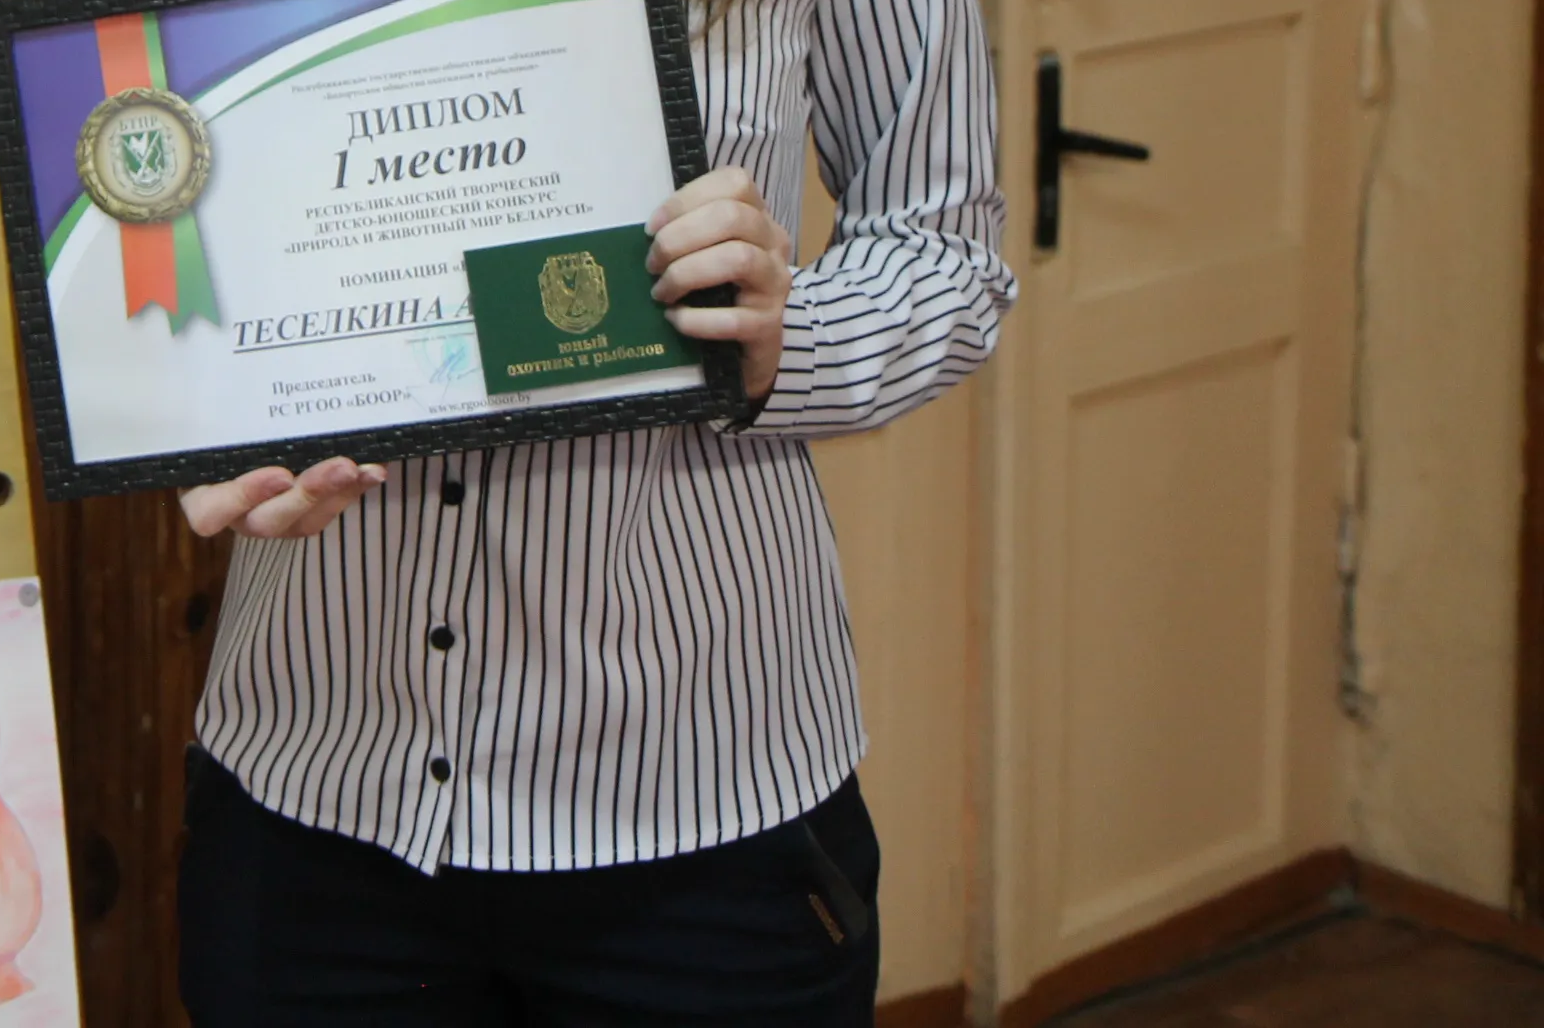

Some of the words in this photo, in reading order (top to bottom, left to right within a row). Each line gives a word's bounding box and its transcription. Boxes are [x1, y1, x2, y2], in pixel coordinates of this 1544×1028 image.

[346, 87, 526, 146] ДИПЛОМ
[367, 136, 527, 185] место
[305, 186, 457, 219] РЕСПУБЛИКАНСКИЙ
[459, 172, 561, 198] ТВОРЧЕСКИЙ
[314, 199, 481, 235] ДЕТСКО-ЮНОШЕСКИЙ
[485, 190, 557, 211] КОНКУРС
[284, 235, 359, 255] «ПРИРОДА
[363, 232, 374, 244] И
[377, 218, 466, 241] ЖИВОТНЫЙ
[470, 214, 503, 229] МИР
[506, 202, 593, 224] БЕЛАРУСИ»
[339, 261, 448, 288] НОМИНАЦИЯ
[233, 296, 443, 347] ТЕСЕЛКИНА
[558, 334, 609, 354] юный
[507, 356, 575, 376] охотник
[577, 353, 590, 366] и
[593, 343, 666, 367] рыболов
[268, 402, 292, 418] РС
[294, 398, 342, 415] РГОО
[346, 389, 411, 408] «БООР»
[272, 373, 376, 396] Председатель
